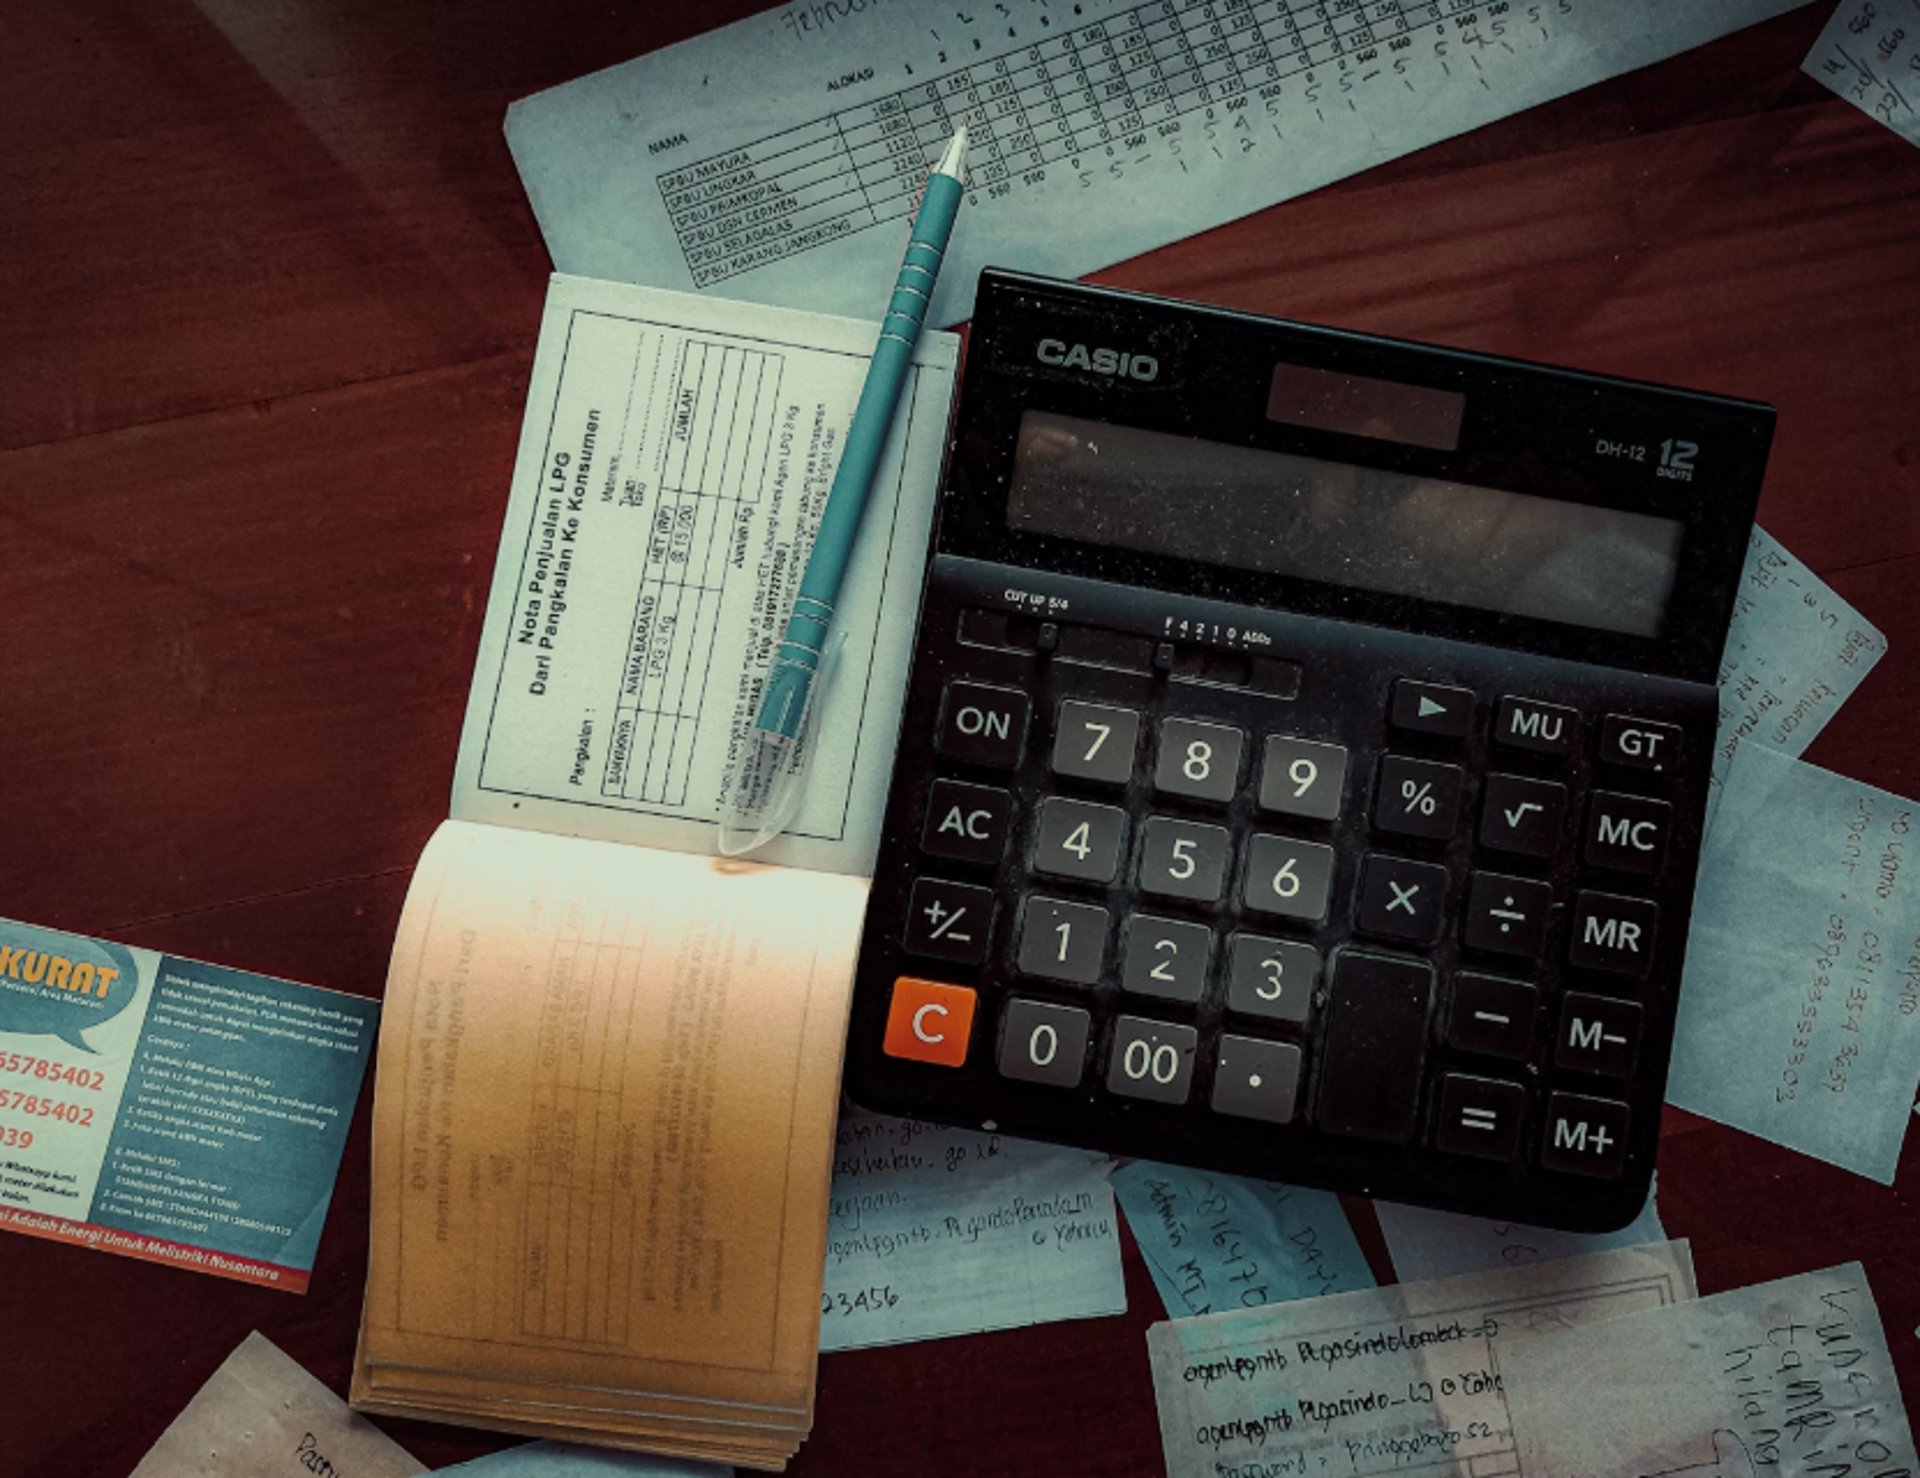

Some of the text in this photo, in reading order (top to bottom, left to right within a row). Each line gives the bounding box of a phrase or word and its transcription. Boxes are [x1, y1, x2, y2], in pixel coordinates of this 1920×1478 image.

[647, 132, 688, 155] NAMA
[693, 151, 751, 179] MAYURA
[1037, 339, 1158, 381] CASIO
[673, 388, 694, 442] JUMLAH
[1596, 438, 1699, 469] DH-12 12
[517, 450, 571, 645] Nota Penjualan LPG
[528, 407, 601, 695] Dari Pangkalan Ke Konsumen
[1004, 589, 1028, 603] CUT
[1030, 594, 1045, 605] UP
[633, 595, 654, 653] BARANG
[656, 613, 676, 634] Kg
[1180, 620, 1188, 631] 4
[1196, 623, 1205, 634] 2
[1226, 628, 1236, 639] 0
[624, 654, 643, 695] NAMA
[648, 648, 665, 679] LPG
[956, 707, 1010, 740] ON
[1084, 722, 1110, 761] 7
[1510, 708, 1562, 740] MU
[568, 718, 595, 786] Pangkalan
[1183, 741, 1212, 781] 8
[1619, 729, 1664, 759] GT
[1289, 759, 1317, 798] 9
[1401, 779, 1436, 815] %
[938, 805, 992, 840] AC
[1062, 822, 1091, 860] 4
[1598, 814, 1657, 851] MC
[1168, 840, 1197, 878] 5
[1272, 858, 1299, 897] 6
[1055, 923, 1072, 961] 1
[1584, 915, 1641, 952] MR
[1150, 939, 1177, 981] 2
[1256, 959, 1283, 999] 3
[912, 1004, 948, 1044] C
[1029, 1024, 1057, 1065] 0
[1124, 1040, 1179, 1083] 00
[1554, 1118, 1614, 1154] M+
[11, 1213, 57, 1232] Adalah
[59, 1222, 102, 1244] Energi
[104, 1230, 144, 1251] Untuk
[146, 1240, 208, 1264] Melistriki
[210, 1256, 278, 1280] Nusantara
